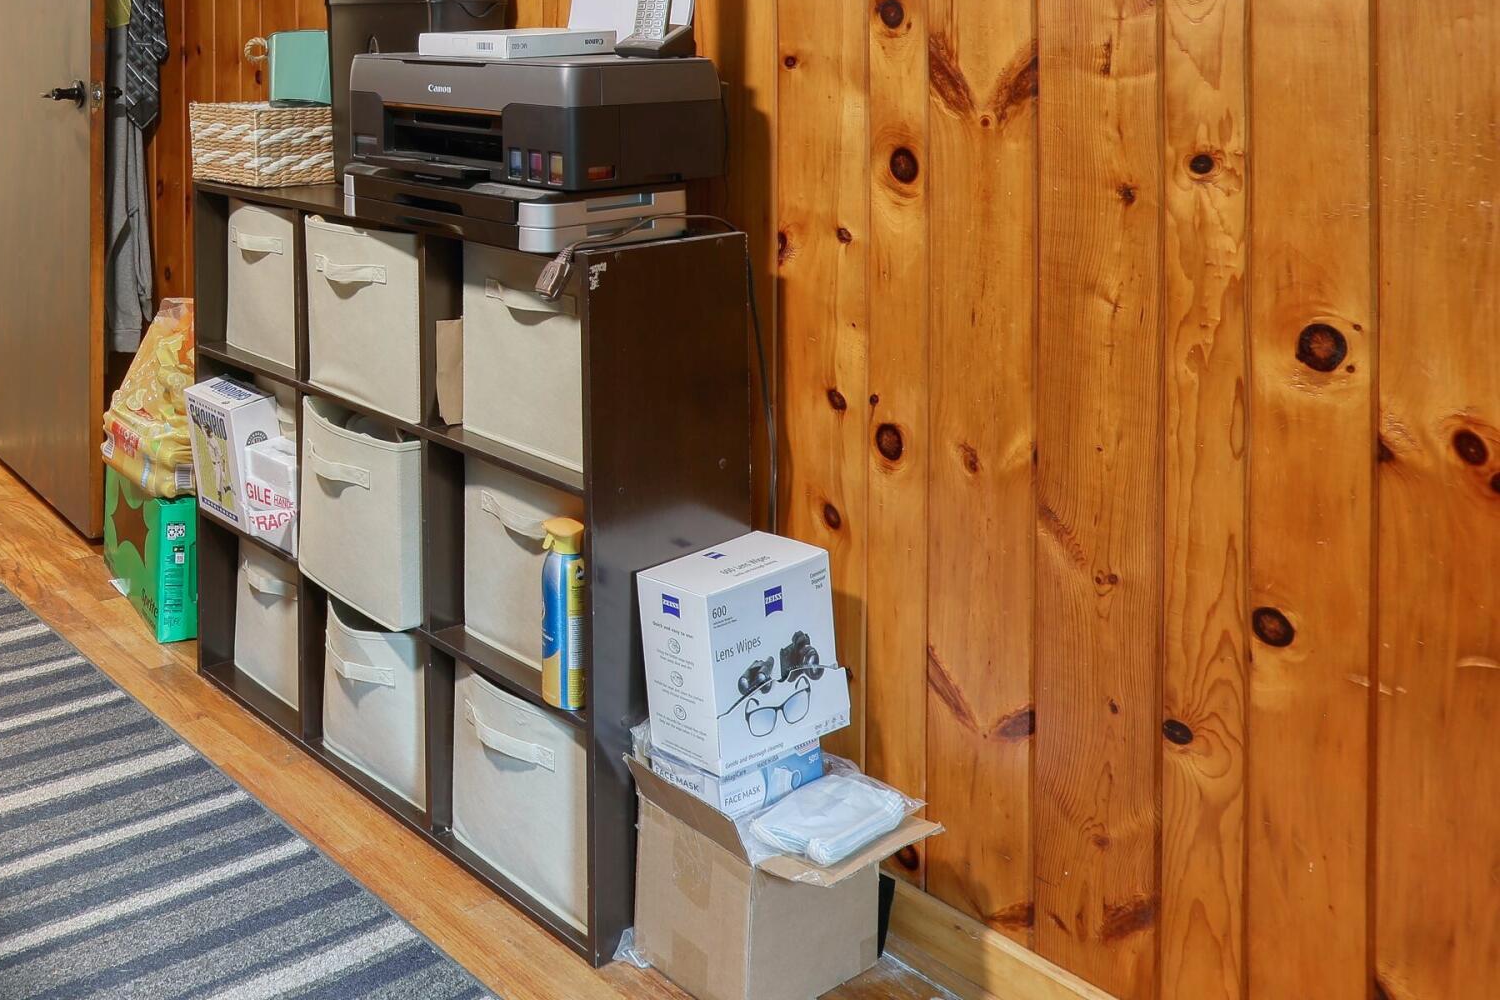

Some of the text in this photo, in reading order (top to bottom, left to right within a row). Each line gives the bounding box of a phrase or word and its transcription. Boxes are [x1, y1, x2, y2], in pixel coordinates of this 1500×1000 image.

[584, 38, 604, 46] Canon
[427, 83, 452, 94] Canon
[662, 599, 680, 609] ZEISS
[764, 592, 784, 605] ZEISS
[712, 604, 727, 619] 600
[715, 636, 762, 662] Lens Wipes
[655, 765, 700, 792] FACE MASK
[724, 794, 742, 807] FACE
[742, 784, 762, 802] MASK
